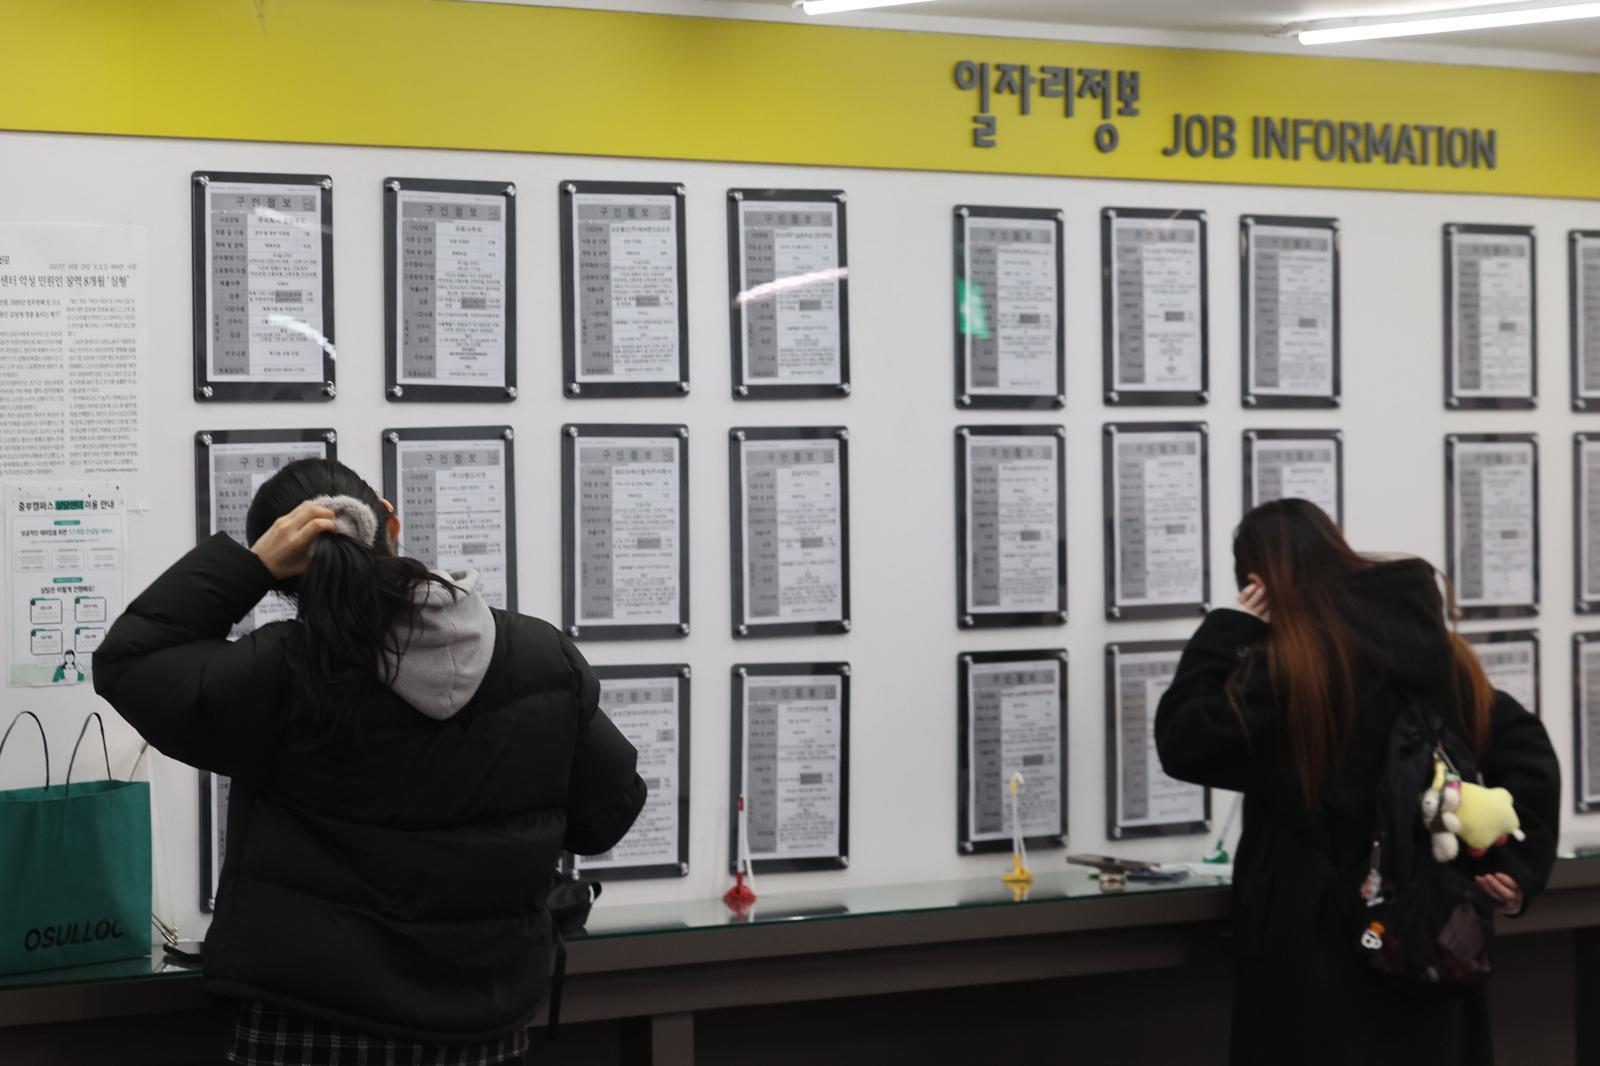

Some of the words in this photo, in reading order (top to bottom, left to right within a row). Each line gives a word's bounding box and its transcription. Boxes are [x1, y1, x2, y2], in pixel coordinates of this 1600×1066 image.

[953, 59, 1139, 152] 일자리정보
[1161, 113, 1237, 159] JOB
[1253, 115, 1497, 169] INFORMATION
